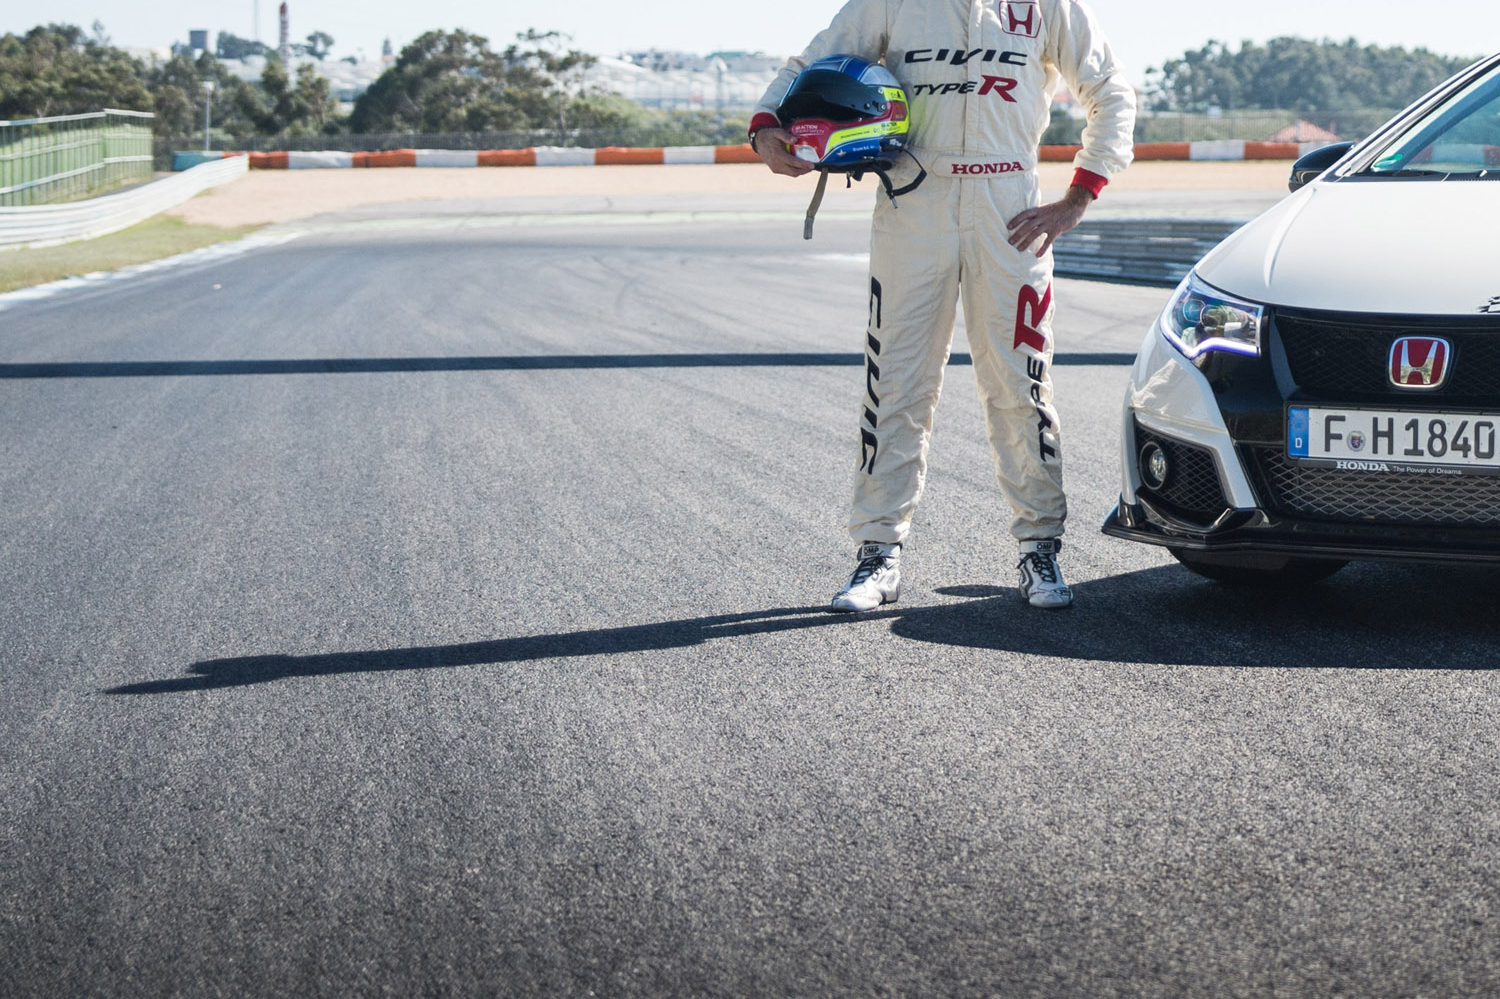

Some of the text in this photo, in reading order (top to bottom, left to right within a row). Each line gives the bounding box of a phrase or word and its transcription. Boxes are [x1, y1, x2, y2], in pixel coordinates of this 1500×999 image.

[904, 48, 1028, 66] CIVIC
[951, 161, 1024, 174] HONDA
[859, 276, 882, 475] CIVIC
[1294, 437, 1303, 449] D
[1335, 460, 1390, 472] HONDA
[1437, 467, 1462, 475] Dreams
[863, 545, 880, 556] OMP
